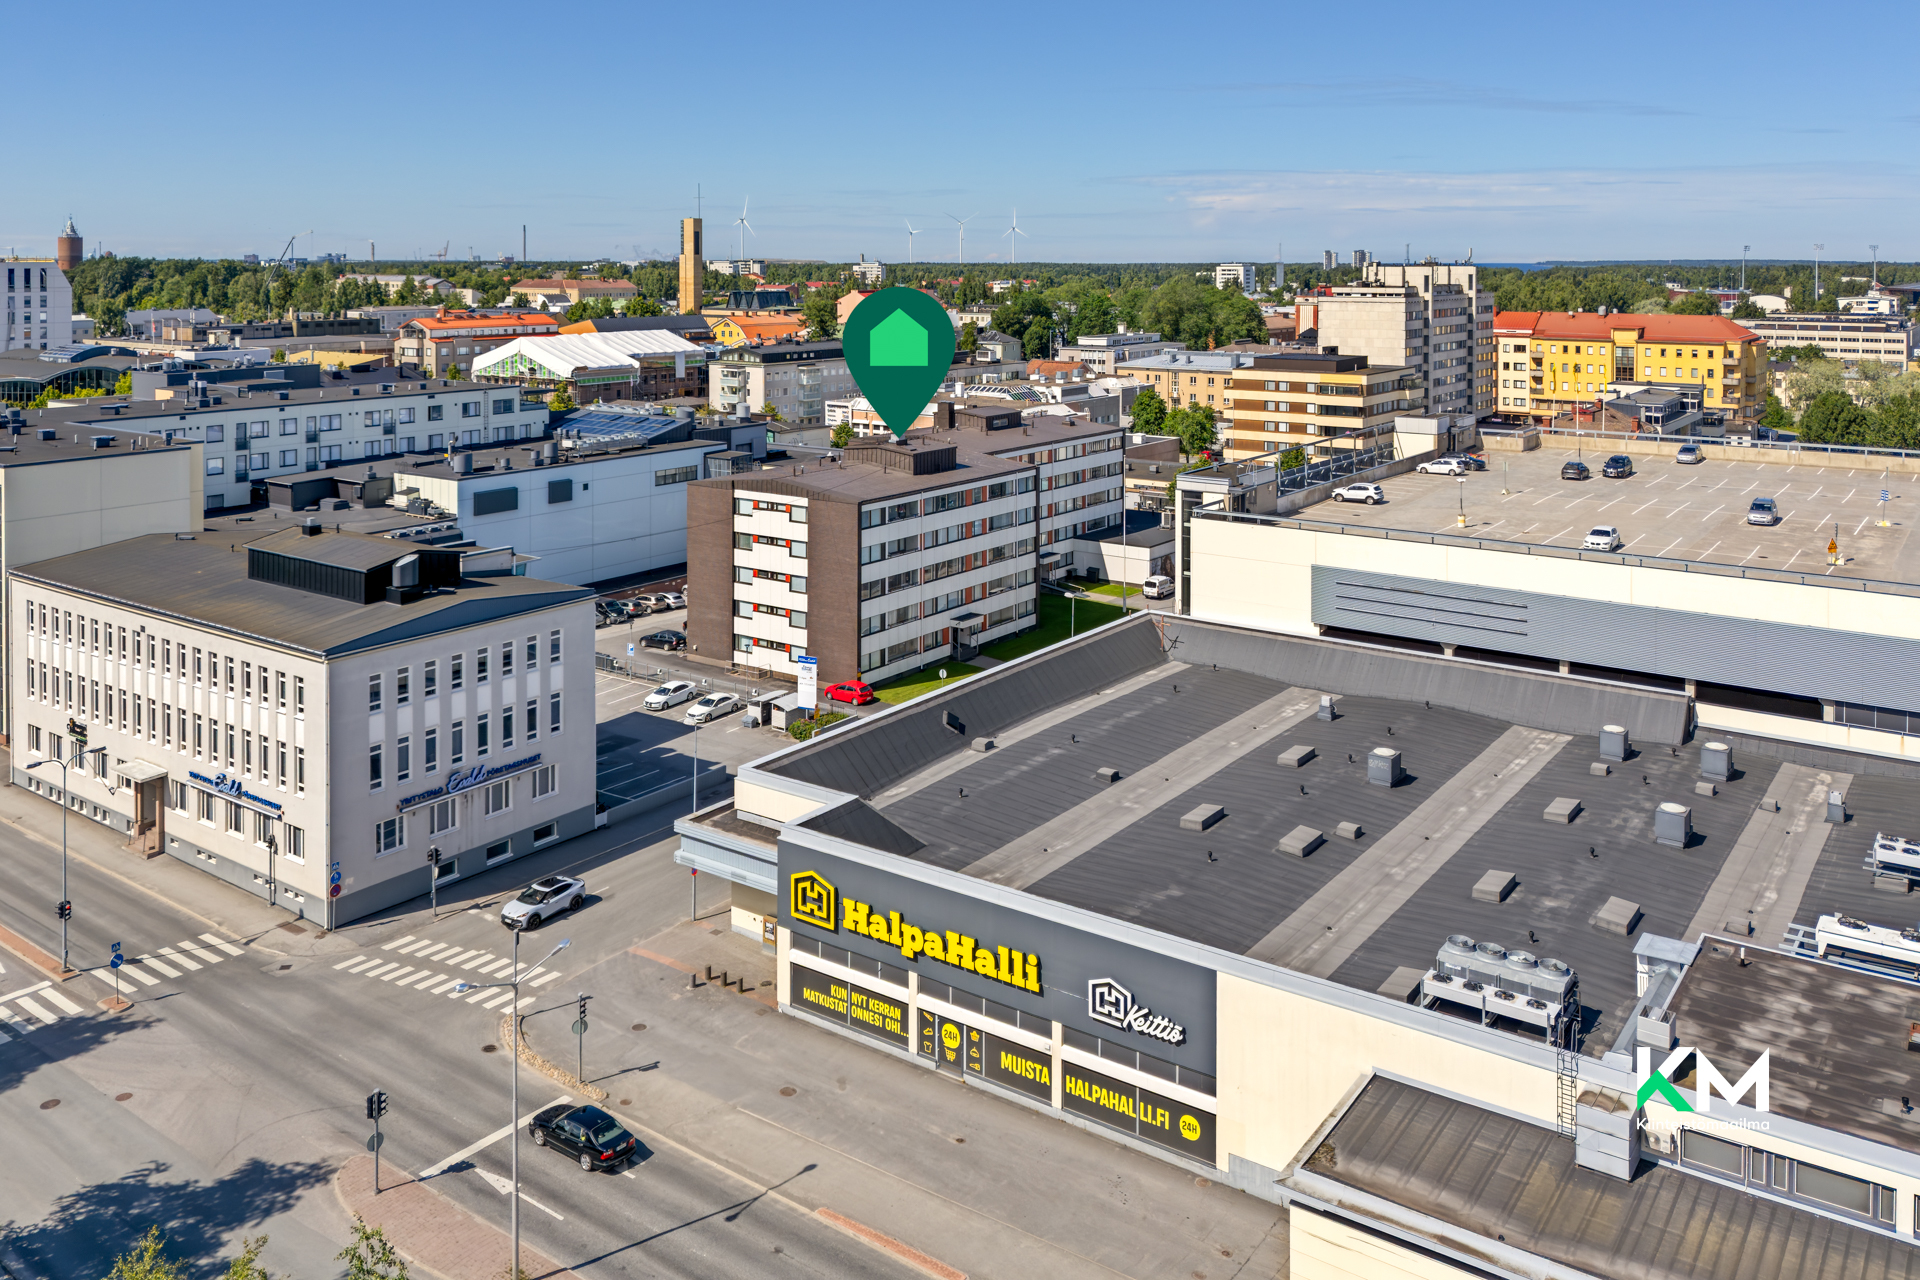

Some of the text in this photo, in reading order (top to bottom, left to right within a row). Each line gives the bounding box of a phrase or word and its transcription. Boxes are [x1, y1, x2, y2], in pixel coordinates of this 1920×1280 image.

[842, 897, 1041, 993] HalpaHalli
[803, 987, 848, 1015] MATKUSTAT
[851, 1005, 883, 1028] ONNESI
[830, 984, 901, 1021] KUN NYT KERRAN
[943, 1029, 958, 1043] 24H
[1000, 1051, 1050, 1086] MUISTA
[1181, 1120, 1198, 1135] 24H
